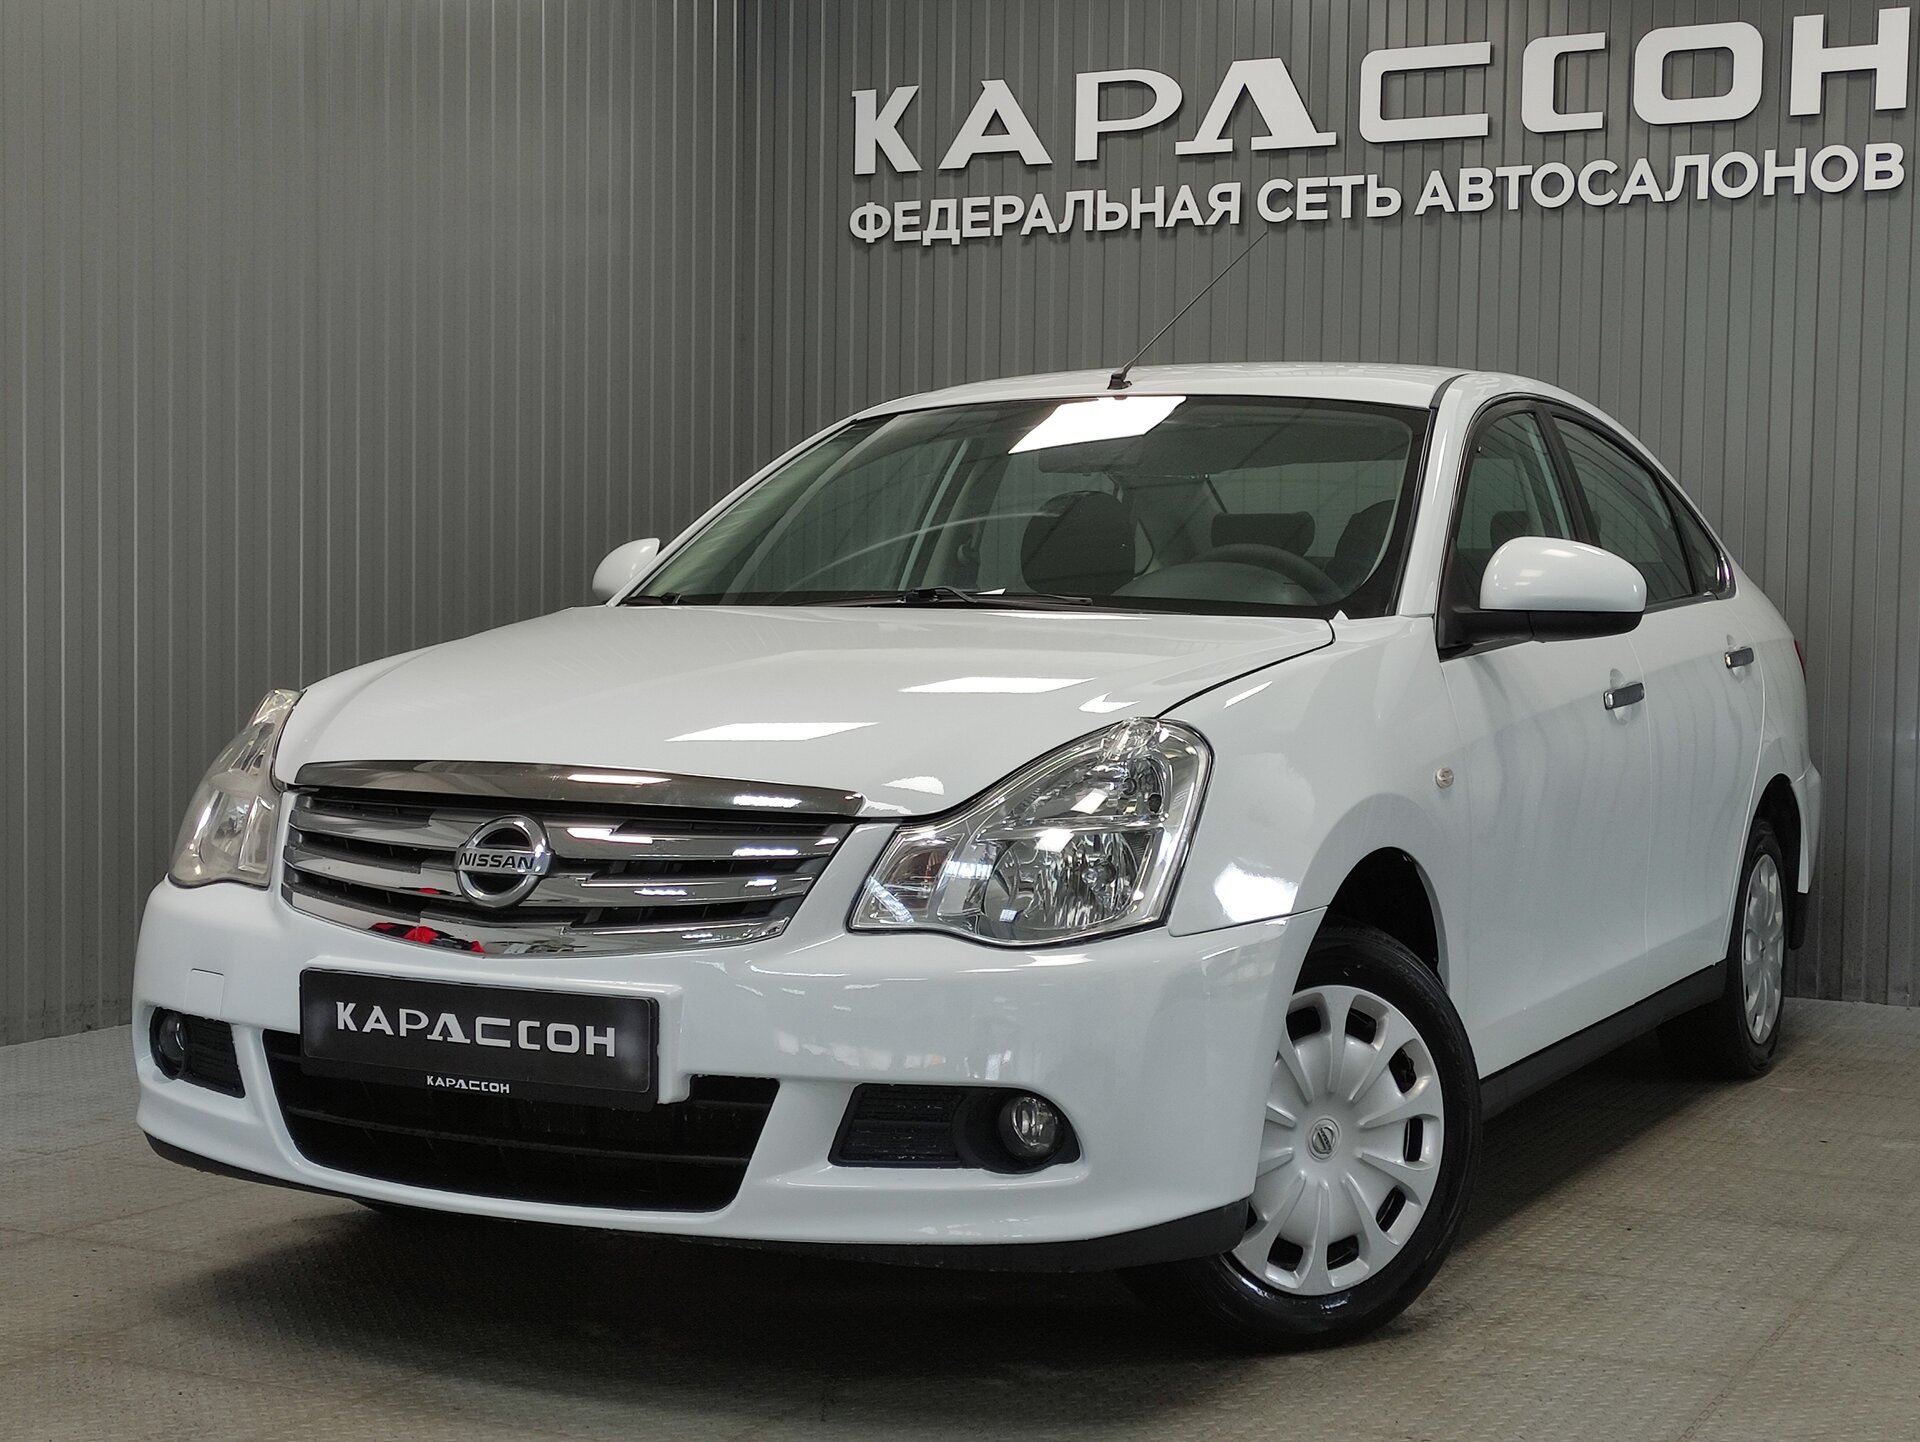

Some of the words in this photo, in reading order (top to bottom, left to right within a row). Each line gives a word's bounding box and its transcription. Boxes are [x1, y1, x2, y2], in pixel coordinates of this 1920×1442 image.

[849, 181, 1242, 246] ФЕДЕРАЛЬНАЯ
[1256, 173, 1403, 223] СЕТЬ
[1413, 142, 1906, 216] АВТОСАЛОНОВ
[459, 852, 535, 870] NISSAN
